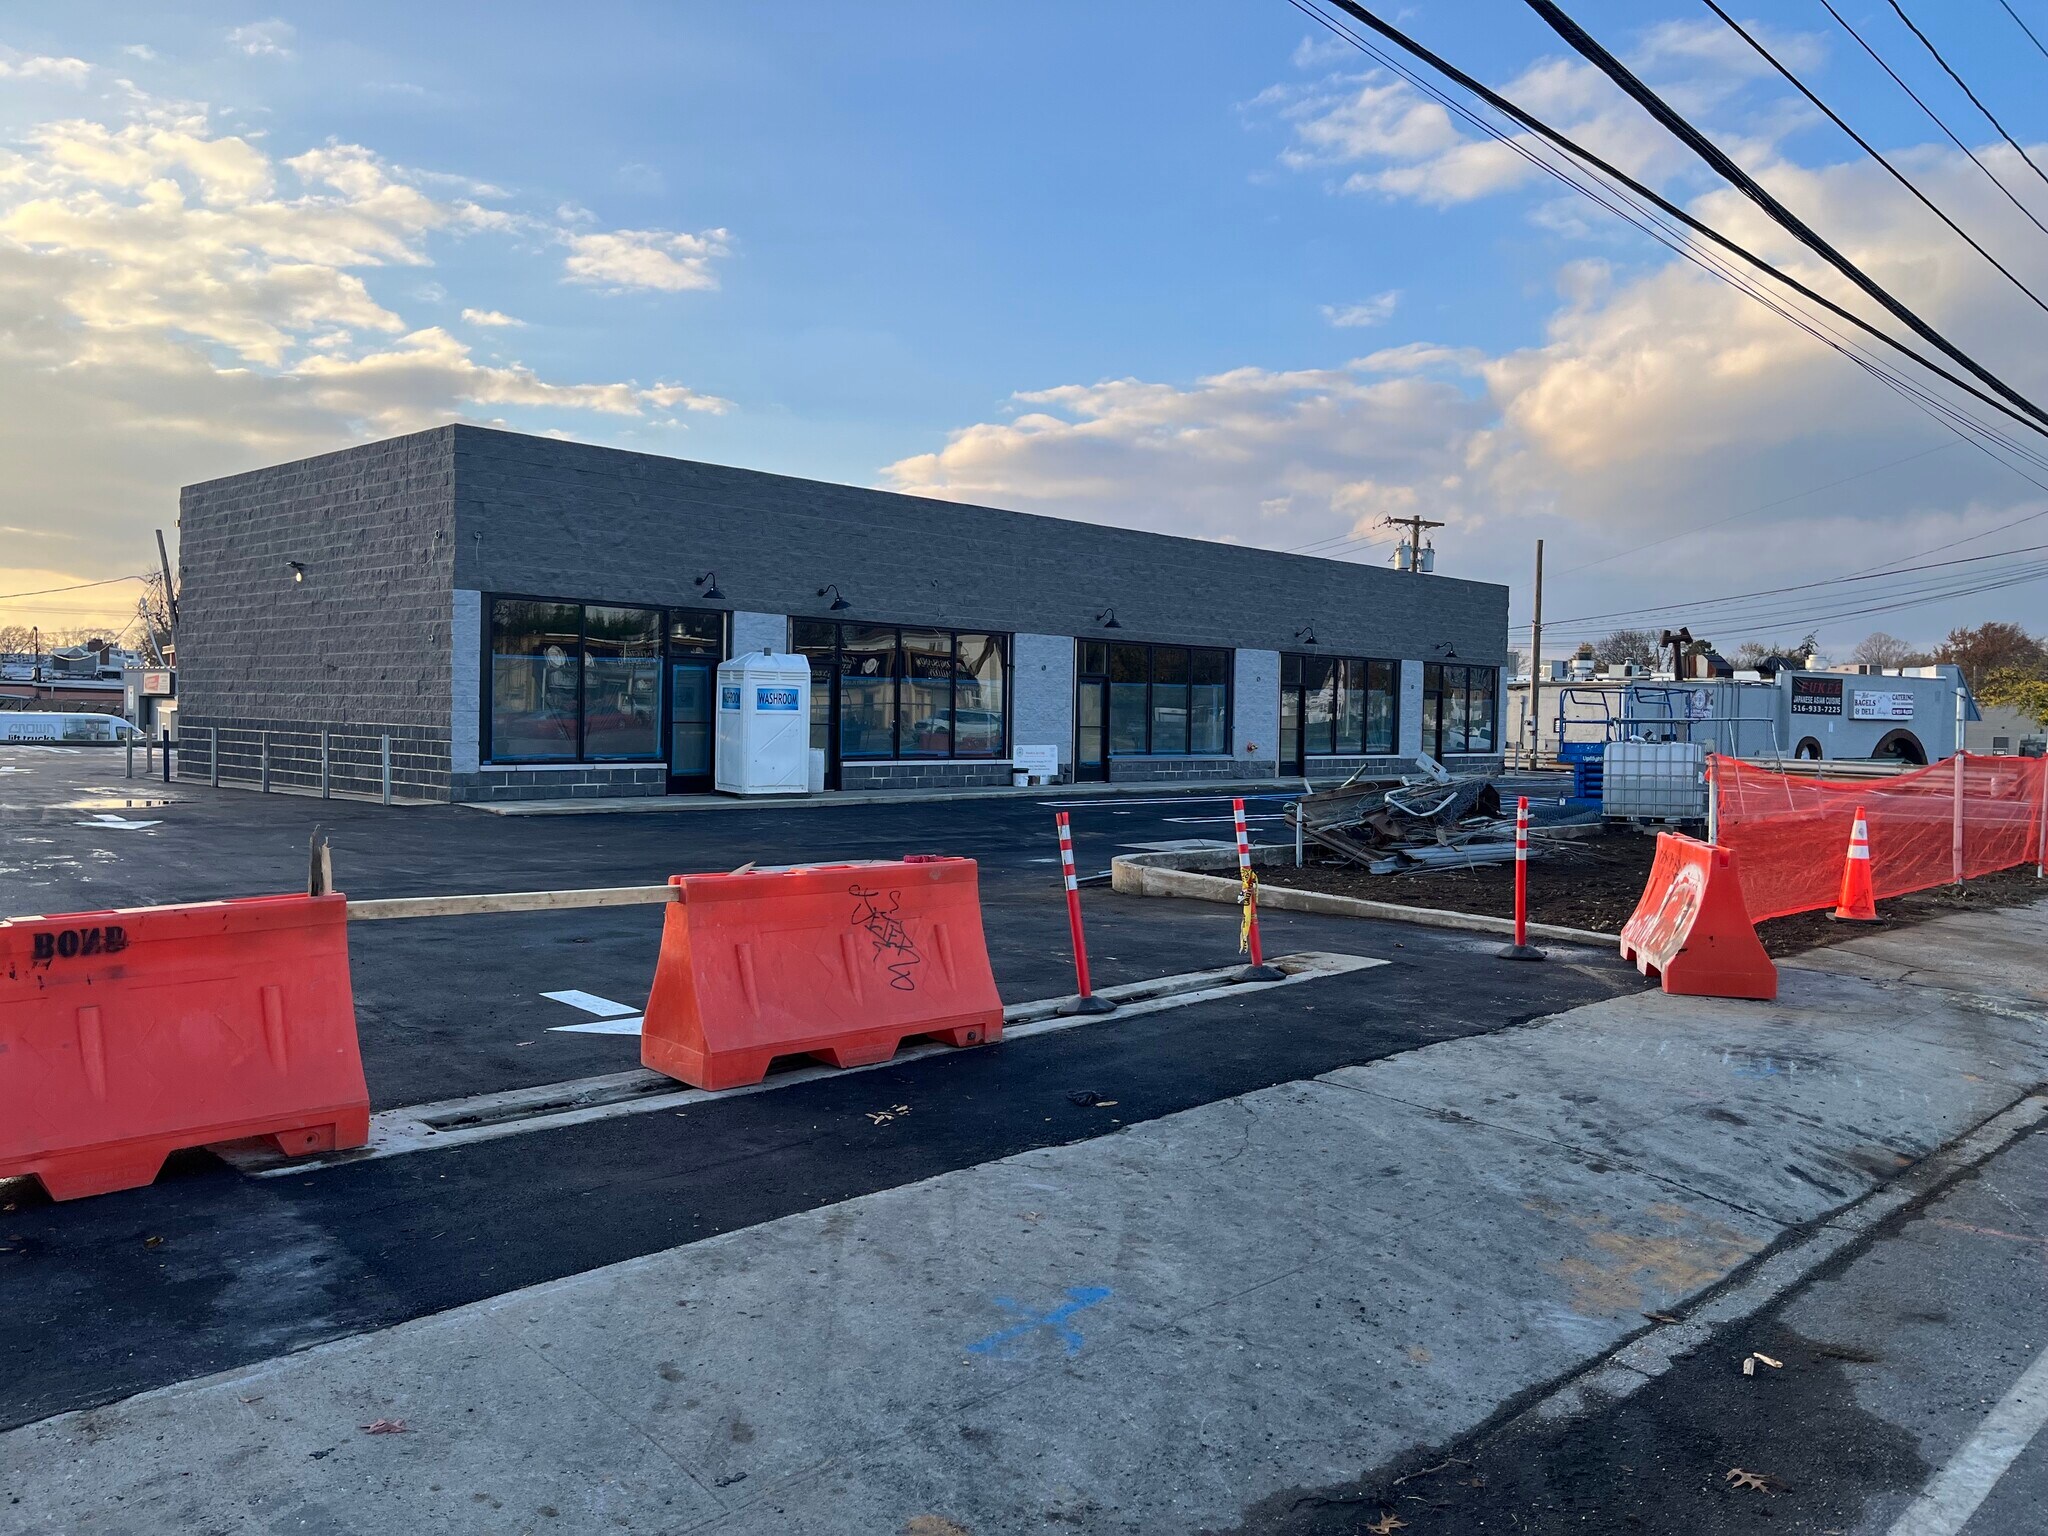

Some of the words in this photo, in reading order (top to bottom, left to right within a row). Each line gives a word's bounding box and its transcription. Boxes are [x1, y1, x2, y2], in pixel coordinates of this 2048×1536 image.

[758, 692, 798, 705] WASHROOM
[1793, 695, 1813, 704] JAPANESE
[1825, 697, 1841, 705] CUISINE
[1793, 705, 1841, 713] 516-933-7225
